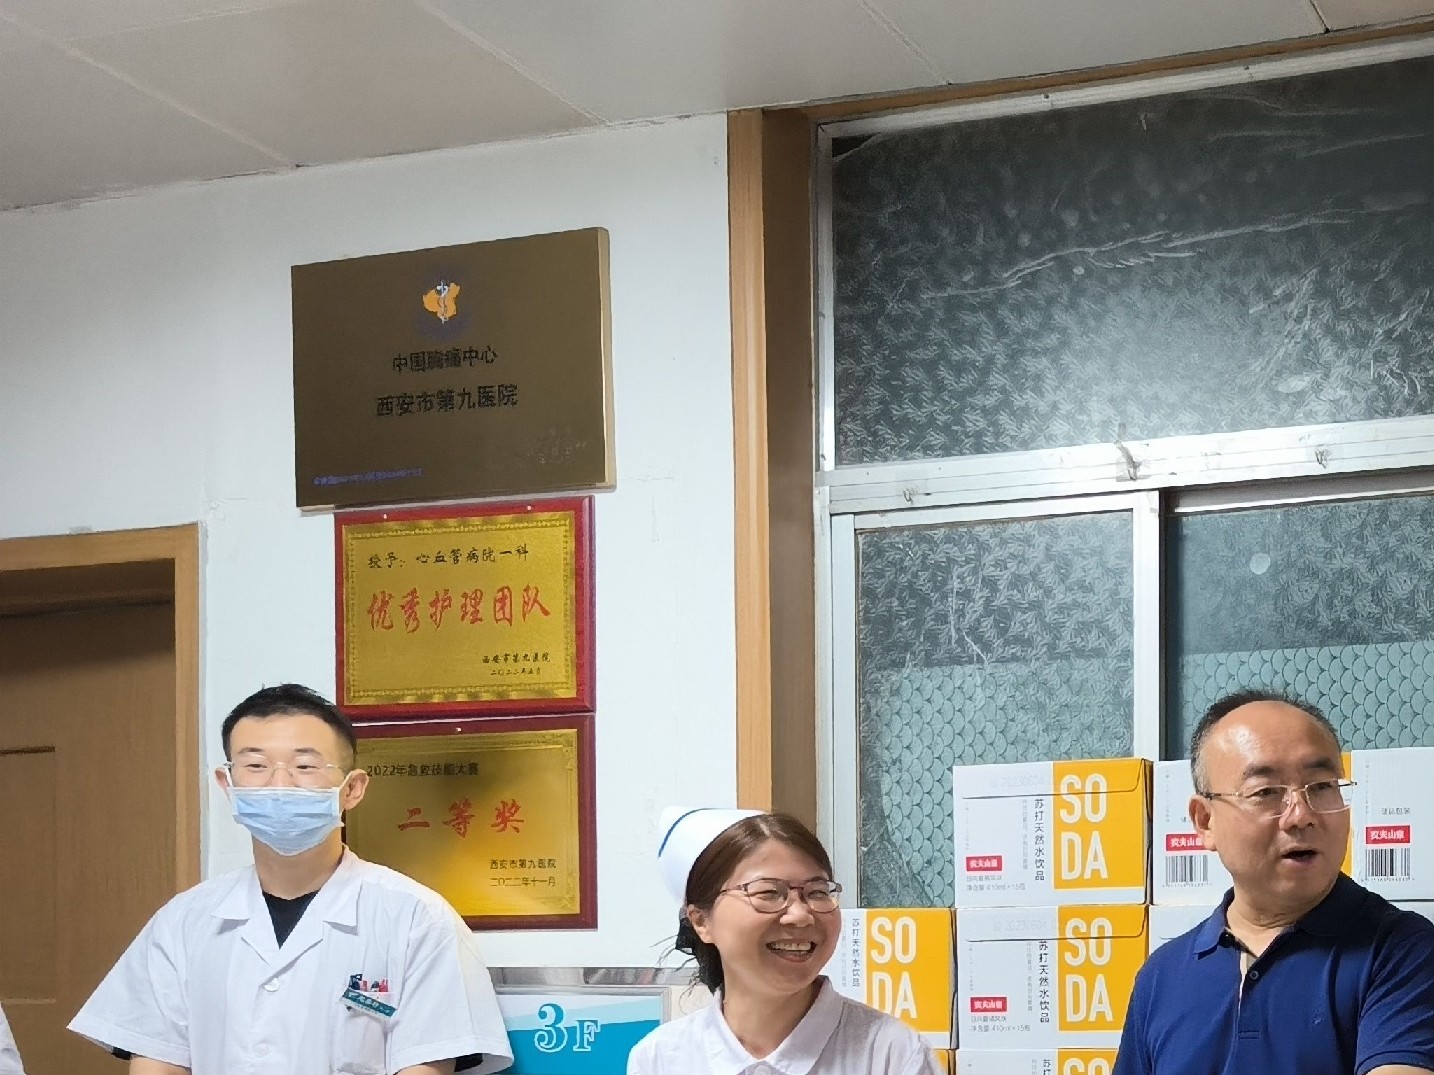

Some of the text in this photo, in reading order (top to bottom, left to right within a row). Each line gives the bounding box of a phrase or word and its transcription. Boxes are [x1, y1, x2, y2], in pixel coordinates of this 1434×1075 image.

[392, 345, 499, 373] 中国胸痛中心
[376, 383, 518, 417] 西安市第九医院
[415, 543, 529, 565] 心血管病院一科
[367, 584, 551, 634] 优秀护理团队
[482, 652, 551, 665] 西安市第九医院
[397, 797, 525, 838] 二等奖
[1059, 773, 1108, 823] SO
[489, 858, 556, 870] 西安市第九医院
[1035, 798, 1044, 881] 苏打天然水饮品
[1061, 830, 1109, 881] DA
[852, 918, 860, 987] 苏打天然水饮品
[870, 917, 916, 964] SO
[1064, 916, 1112, 966] SO
[872, 973, 917, 1019] DA
[1039, 940, 1049, 1023] 苏打天然水饮品
[1066, 973, 1114, 1023] DA
[534, 1003, 600, 1052] 3F
